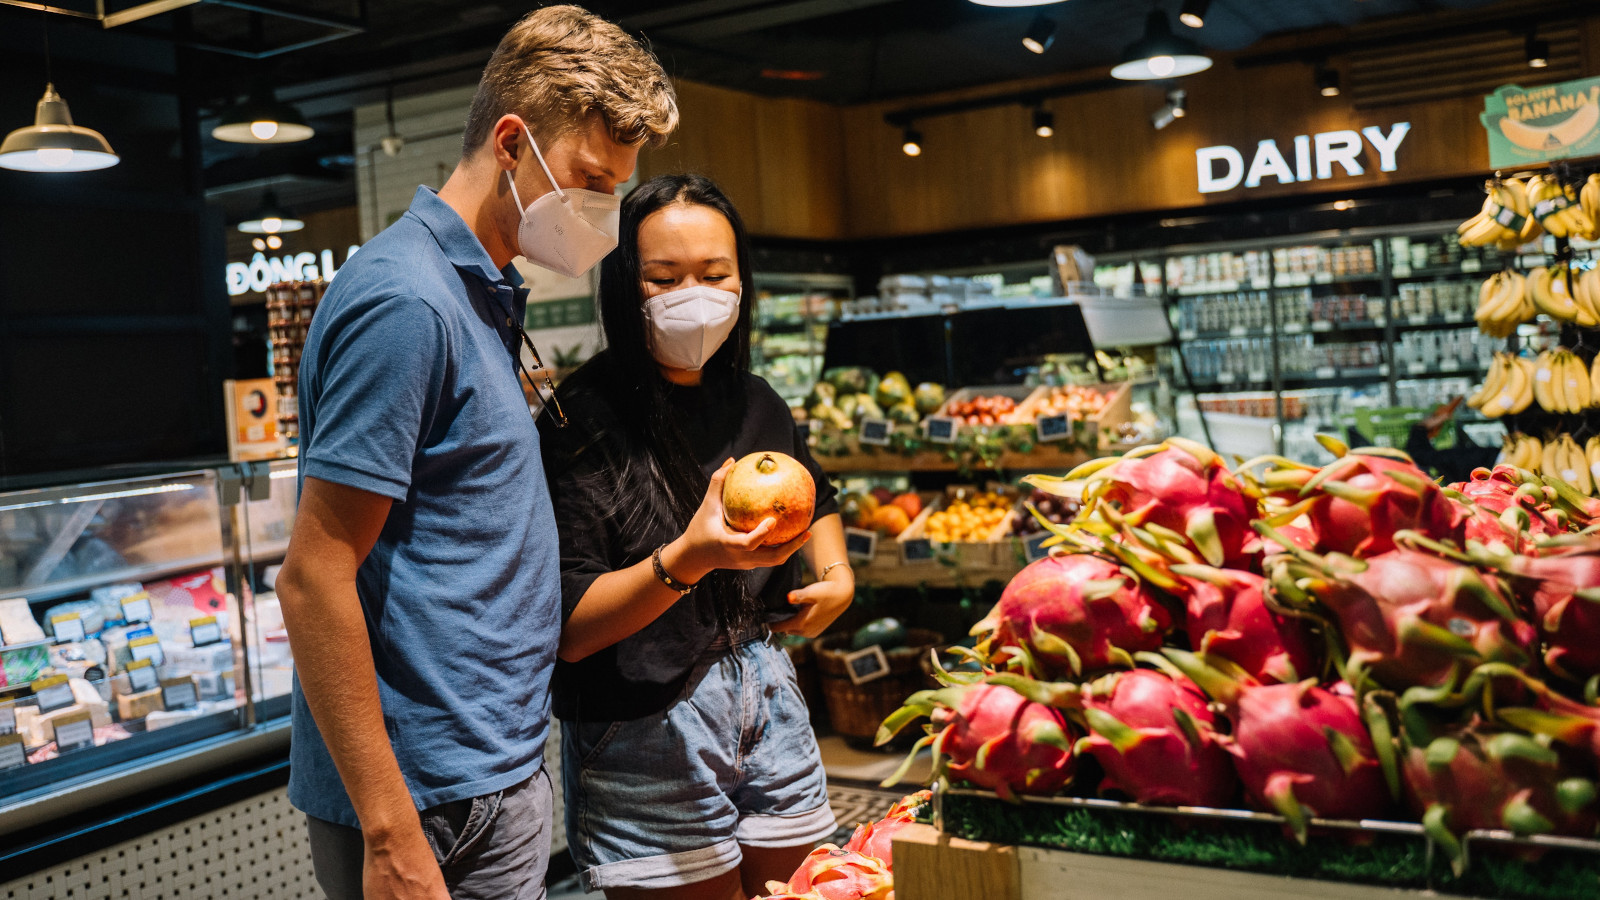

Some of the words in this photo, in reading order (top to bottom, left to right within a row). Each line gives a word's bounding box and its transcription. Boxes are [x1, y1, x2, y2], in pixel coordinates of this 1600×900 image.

[1507, 91, 1589, 122] BANANA
[1195, 121, 1411, 194] DAIRY
[225, 251, 319, 296] ĐÔNG
